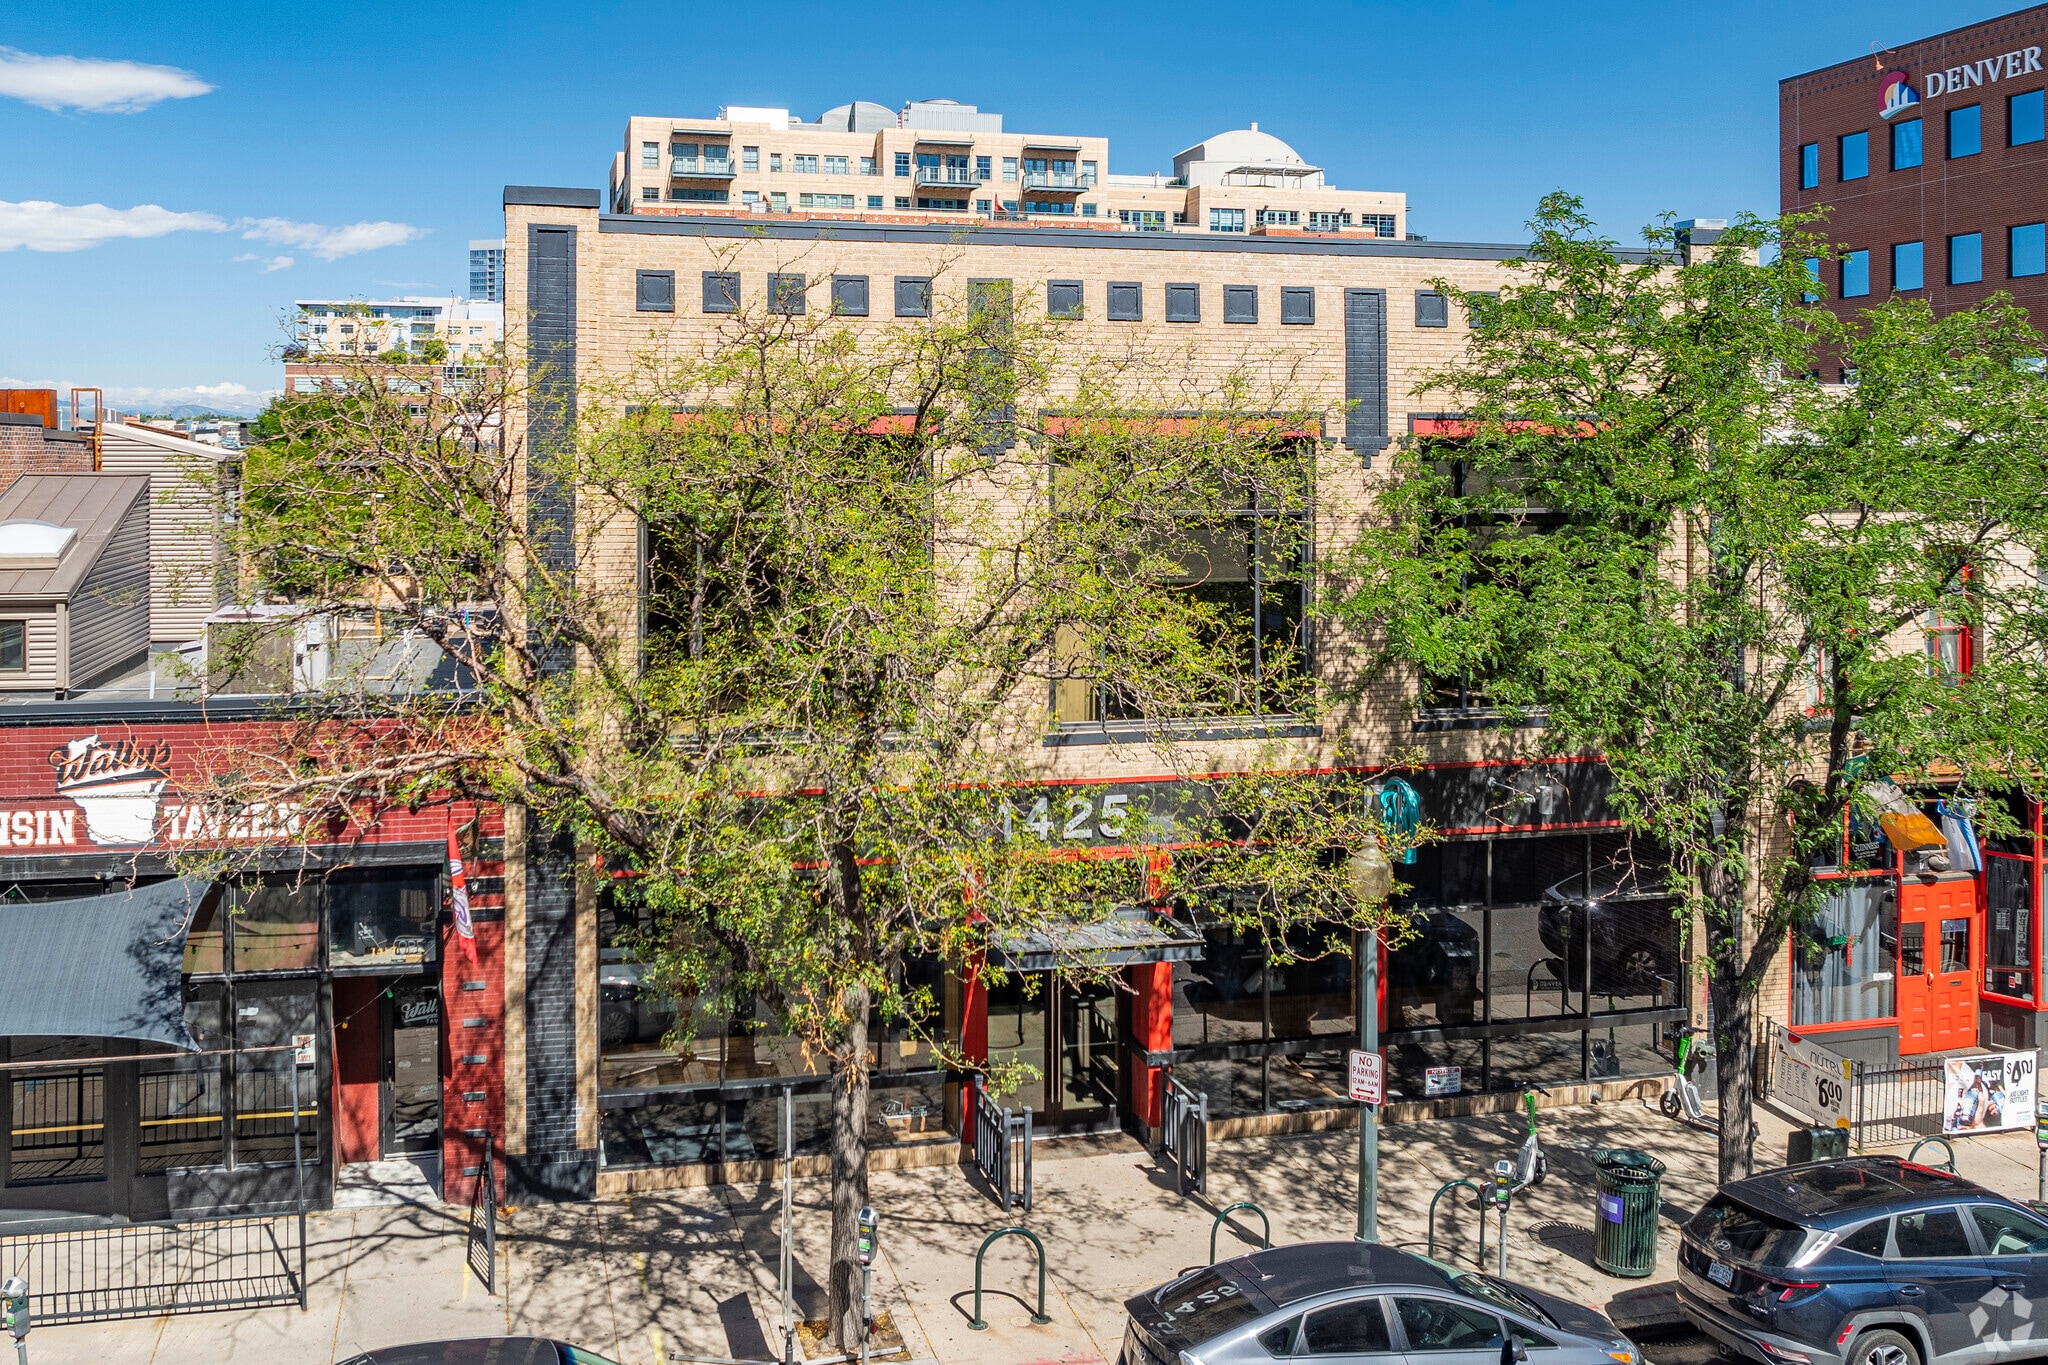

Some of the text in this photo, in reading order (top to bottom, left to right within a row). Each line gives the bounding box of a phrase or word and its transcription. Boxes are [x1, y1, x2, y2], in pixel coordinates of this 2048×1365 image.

[1925, 46, 2043, 98] DENVER
[49, 736, 172, 785] Wally's
[1000, 794, 1128, 842] 1425
[401, 998, 438, 1019] Wall
[1353, 1066, 1379, 1080] PARKING
[1359, 1056, 1373, 1067] NO
